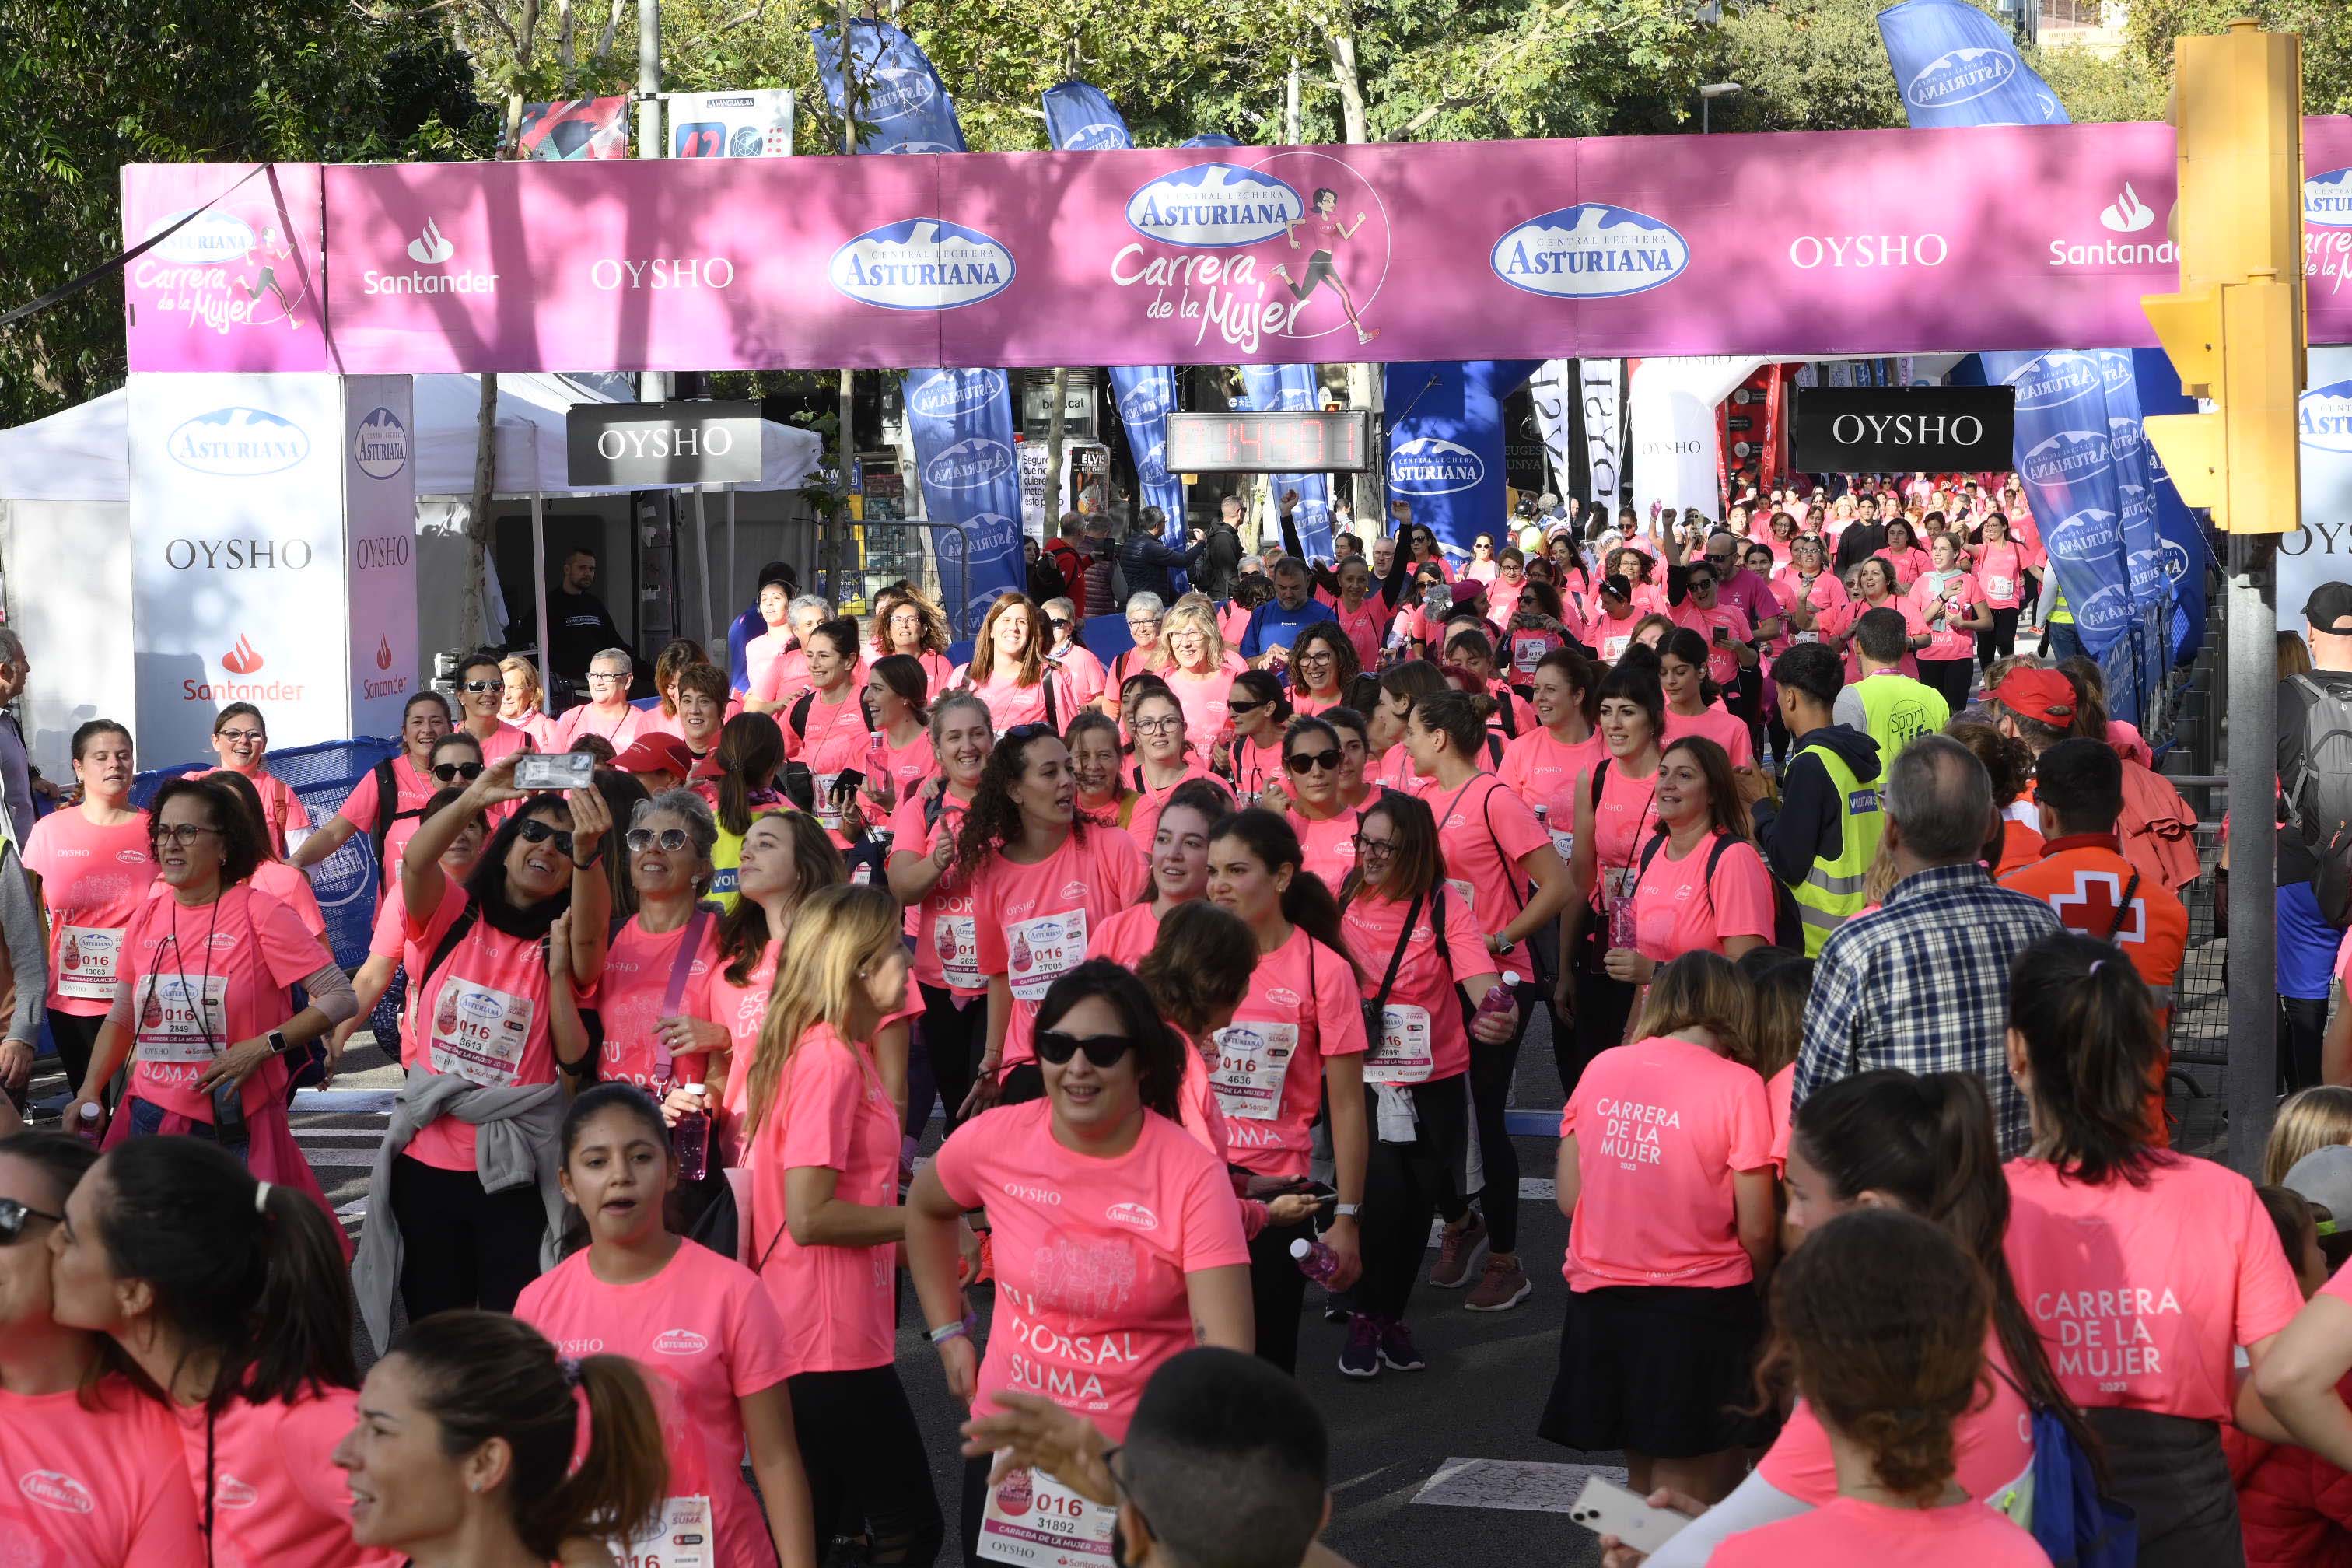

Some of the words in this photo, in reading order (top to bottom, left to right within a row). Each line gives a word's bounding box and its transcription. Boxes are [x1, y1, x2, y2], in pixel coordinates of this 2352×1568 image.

[715, 98, 754, 107] VANGUARDIA
[1227, 191, 1284, 200] LECHERA
[1139, 196, 1289, 226] ASTURIANA
[1536, 236, 1597, 247] CENTRAL
[1604, 234, 1667, 245] LECHERA
[1790, 233, 1948, 268] OYSHO
[872, 250, 929, 259] CENTRAL
[936, 248, 995, 258] LECHERA
[1506, 241, 1673, 275] ASTURIANA
[2049, 238, 2179, 266] Santand
[135, 261, 226, 289] Carrera
[591, 257, 734, 291] OYSHO
[846, 252, 1001, 286] ASTURIANA
[1111, 243, 1258, 287] Carrera
[363, 270, 499, 295] Santander
[158, 290, 175, 311] de
[178, 290, 192, 311] la
[188, 285, 261, 335] Mujer
[1147, 289, 1174, 318] de
[1180, 288, 1199, 318] la
[1195, 281, 1311, 355] Mujer
[1832, 414, 1983, 446] OYSHO
[180, 433, 301, 459] ASTURIANA
[359, 434, 404, 463] ASTURIANA
[597, 427, 733, 460] OYSHO
[1642, 440, 1701, 455] OYSHO
[1081, 453, 1106, 464] ELVIS
[1024, 477, 1048, 487] quiere
[1390, 462, 1477, 482] ASTURIANA
[165, 538, 313, 570] OYSHO
[357, 534, 408, 570] OYSHO
[1932, 635, 1953, 644] UMA
[183, 678, 305, 701] Santander
[363, 675, 407, 700] Santander
[1891, 706, 1926, 733] Sport
[1533, 766, 1562, 775] OYSHO
[58, 849, 89, 858] OYSHO
[714, 874, 739, 887] VOL
[936, 896, 973, 913] DOR
[1006, 898, 1036, 916] OYSHO
[958, 944, 975, 955] 01
[1034, 947, 1062, 961] 016
[82, 955, 110, 966] 016
[1038, 963, 1062, 972] 27005
[64, 984, 86, 992] OYSHO
[1020, 975, 1041, 985] CARRERA
[1017, 987, 1045, 996] OYSHO
[164, 1008, 195, 1022] 016
[169, 1024, 189, 1033] 2849
[460, 1020, 492, 1040] 016
[145, 1047, 170, 1055] OYSHO
[460, 1038, 483, 1052] 3613
[1223, 1055, 1257, 1073] 016
[1596, 1097, 1681, 1129] CARRERA
[1606, 1119, 1628, 1139] DE
[1635, 1126, 1660, 1145] LA
[1600, 1139, 1661, 1165] MUJER
[1620, 1162, 1636, 1171] 2023
[1004, 1182, 1062, 1206] OYSHO
[2035, 1287, 2182, 1321] CARRERA
[1012, 1315, 1139, 1366] DORSAL
[2060, 1320, 2102, 1348] DE
[2115, 1318, 2154, 1346] LA
[554, 1338, 604, 1353] YSHO
[656, 1337, 704, 1350] ASTURIANA
[2057, 1347, 2163, 1377] MUJER
[1010, 1354, 1104, 1399] SUMA
[2098, 1381, 2127, 1393] 2023
[1036, 1493, 1083, 1517] 016
[672, 1515, 702, 1525] SUMA
[1037, 1517, 1075, 1534] 31892
[998, 1524, 1038, 1541] CARRERA
[1038, 1534, 1050, 1544] DE
[1051, 1537, 1062, 1546] LA
[1062, 1538, 1091, 1551] MUJER
[992, 1540, 1034, 1559] OYSHO
